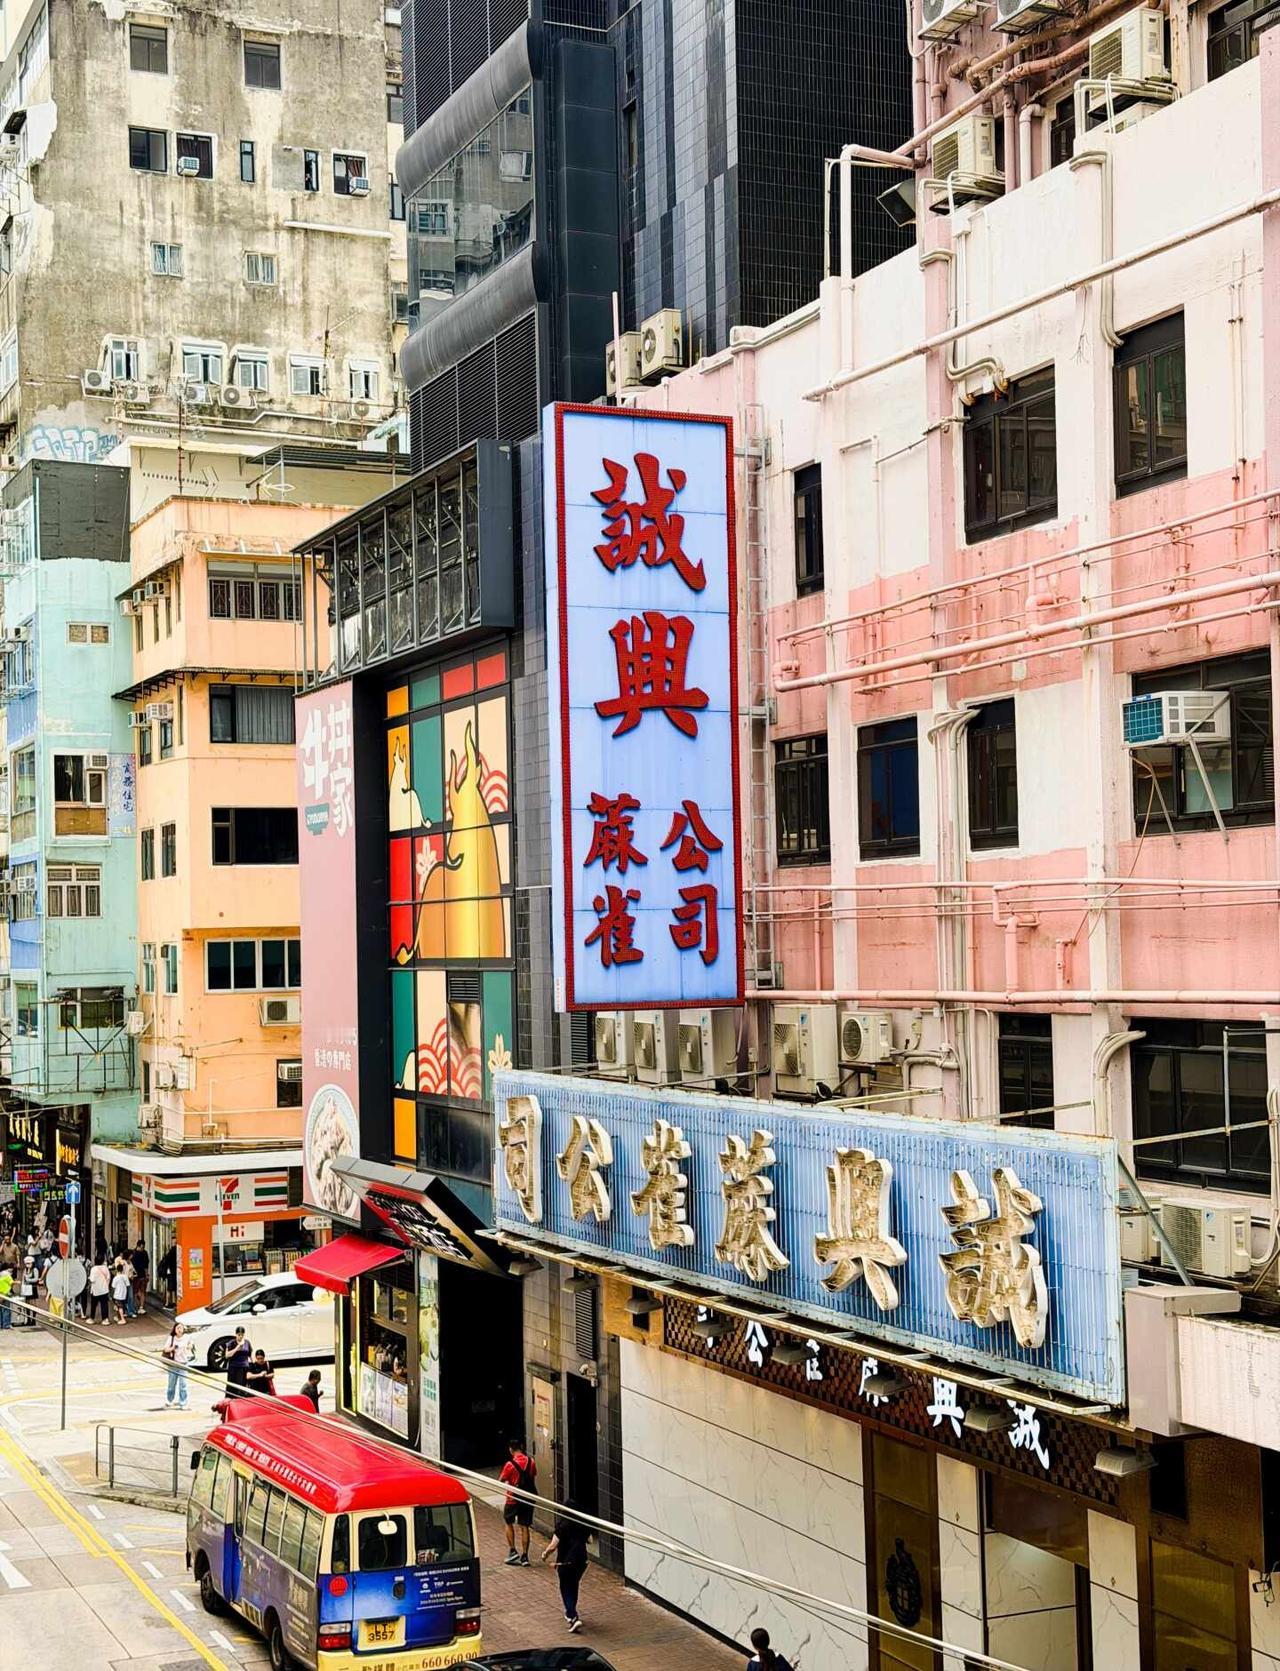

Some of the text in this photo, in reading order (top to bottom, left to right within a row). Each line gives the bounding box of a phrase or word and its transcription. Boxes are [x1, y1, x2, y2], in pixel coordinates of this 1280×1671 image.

[590, 452, 708, 738] 誠興
[660, 800, 723, 967] 公司
[230, 1226, 244, 1237] Hi
[368, 1631, 394, 1641] 3557
